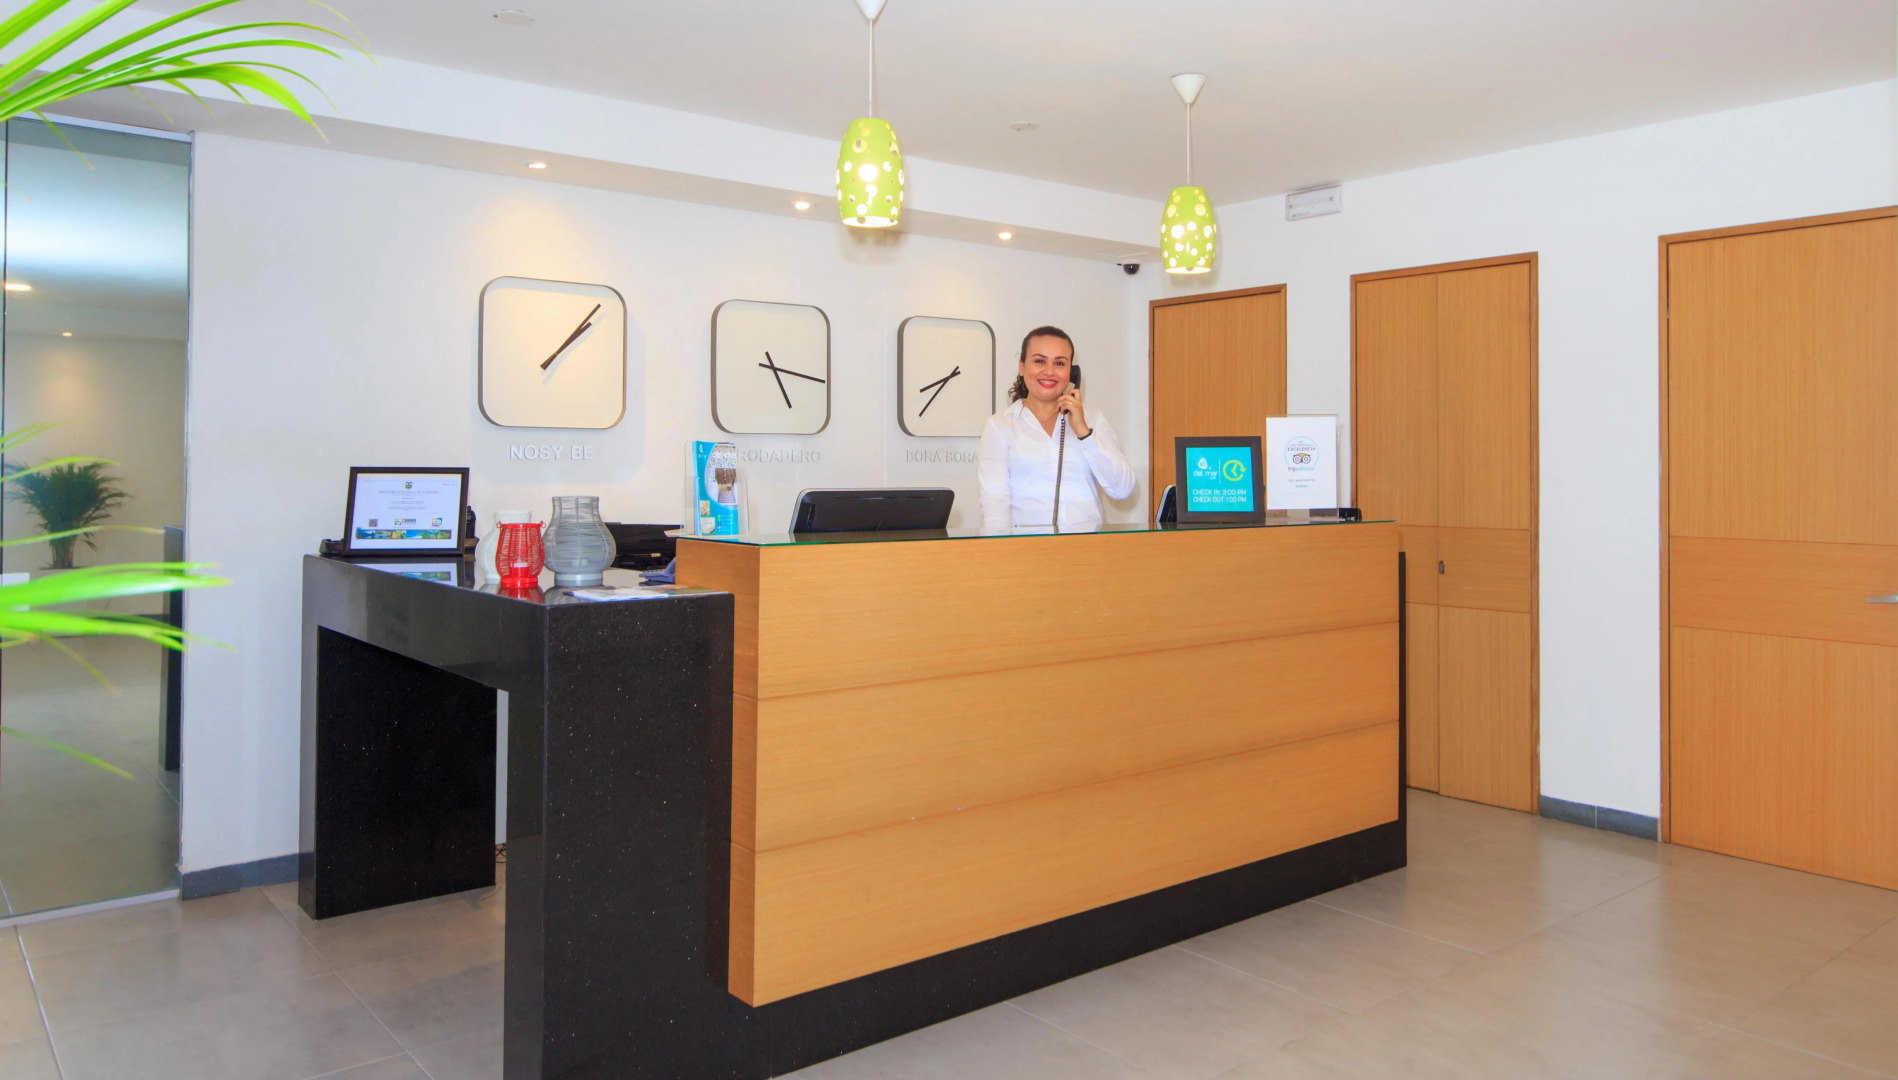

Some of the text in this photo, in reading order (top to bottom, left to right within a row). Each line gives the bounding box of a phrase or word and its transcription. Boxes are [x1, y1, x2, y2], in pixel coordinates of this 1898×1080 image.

[510, 444, 595, 461] NOSY BE
[736, 448, 821, 464] RODADERO
[906, 449, 979, 463] BORA BORA
[1192, 488, 1212, 496] CHECK
[1237, 488, 1247, 496] PM
